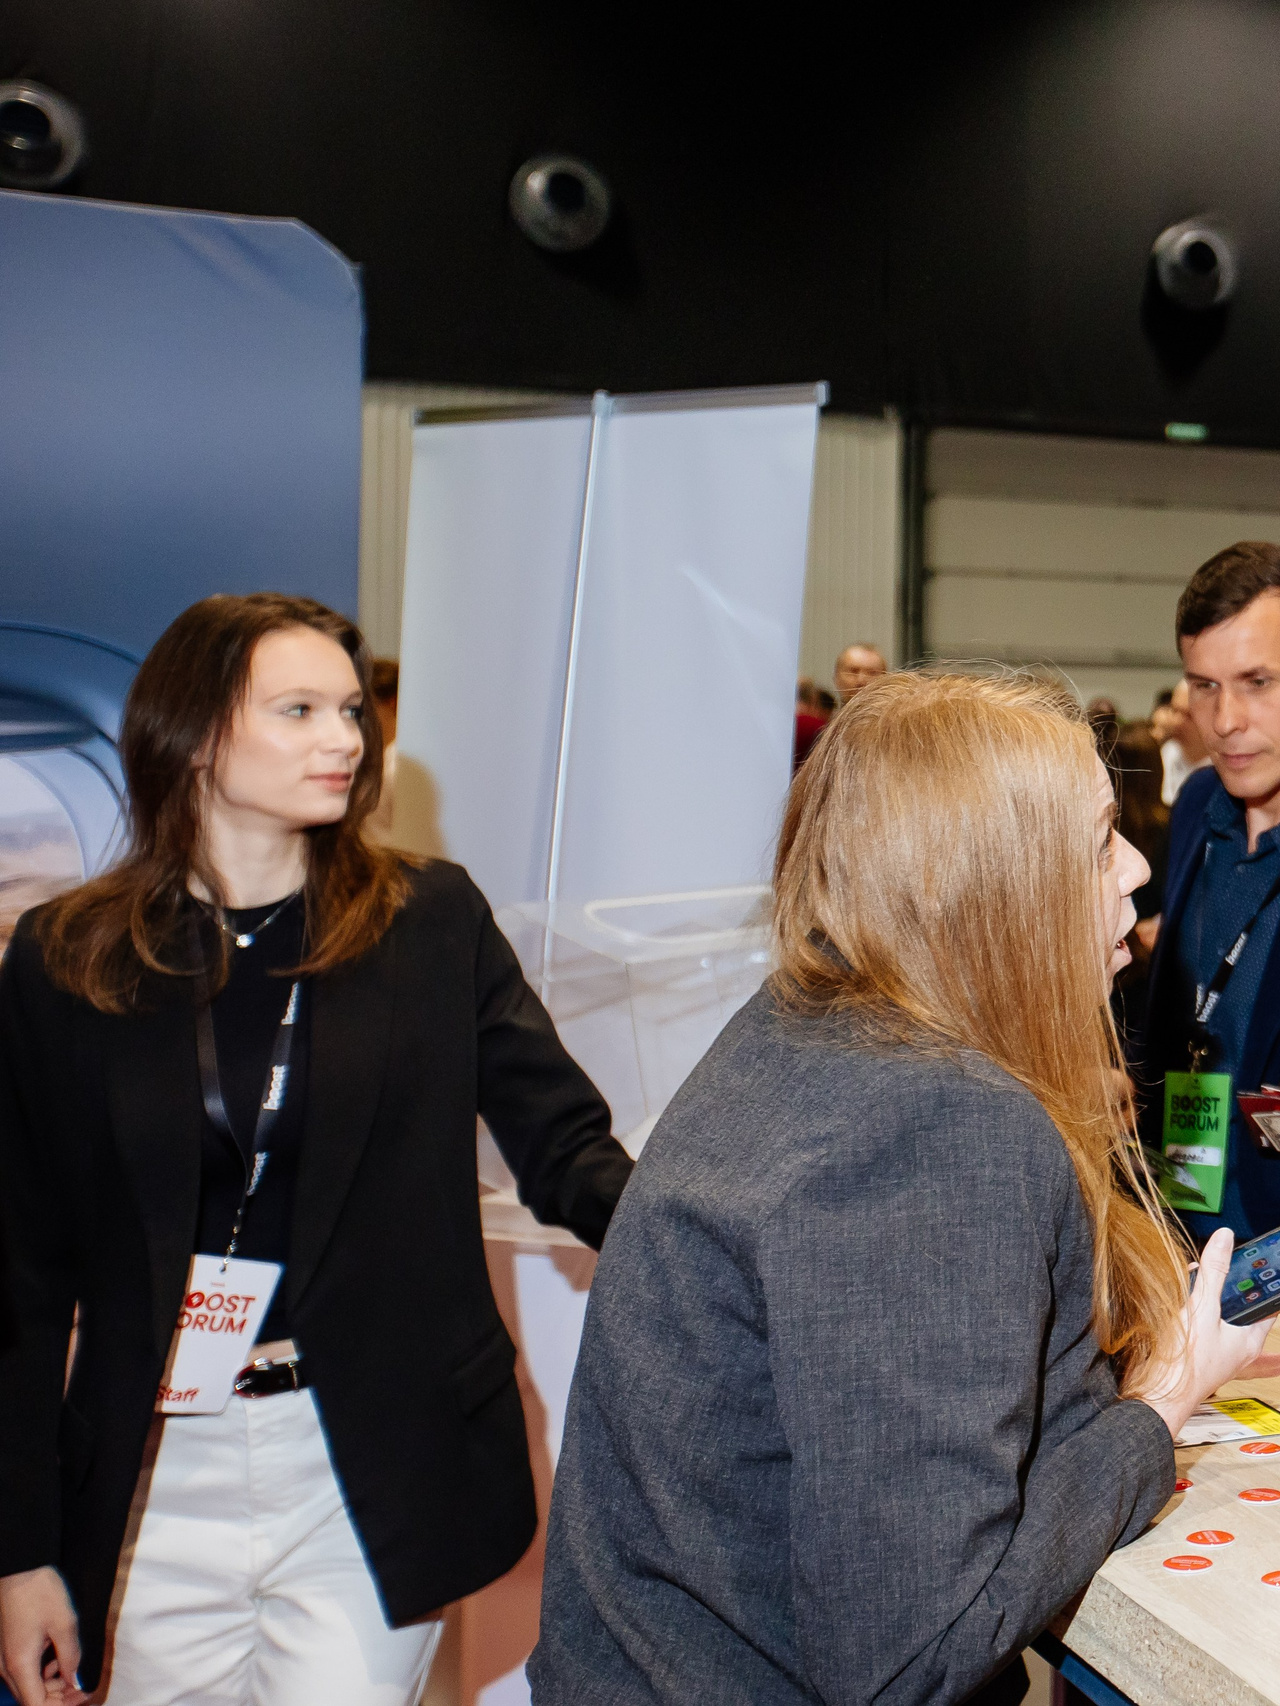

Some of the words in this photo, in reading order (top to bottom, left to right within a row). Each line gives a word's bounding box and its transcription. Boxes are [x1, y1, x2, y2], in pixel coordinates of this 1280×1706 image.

[1170, 1094, 1220, 1114] BOOST
[1169, 1111, 1219, 1132] FORUM
[185, 1291, 256, 1314] OOST
[176, 1311, 247, 1334] ORUM
